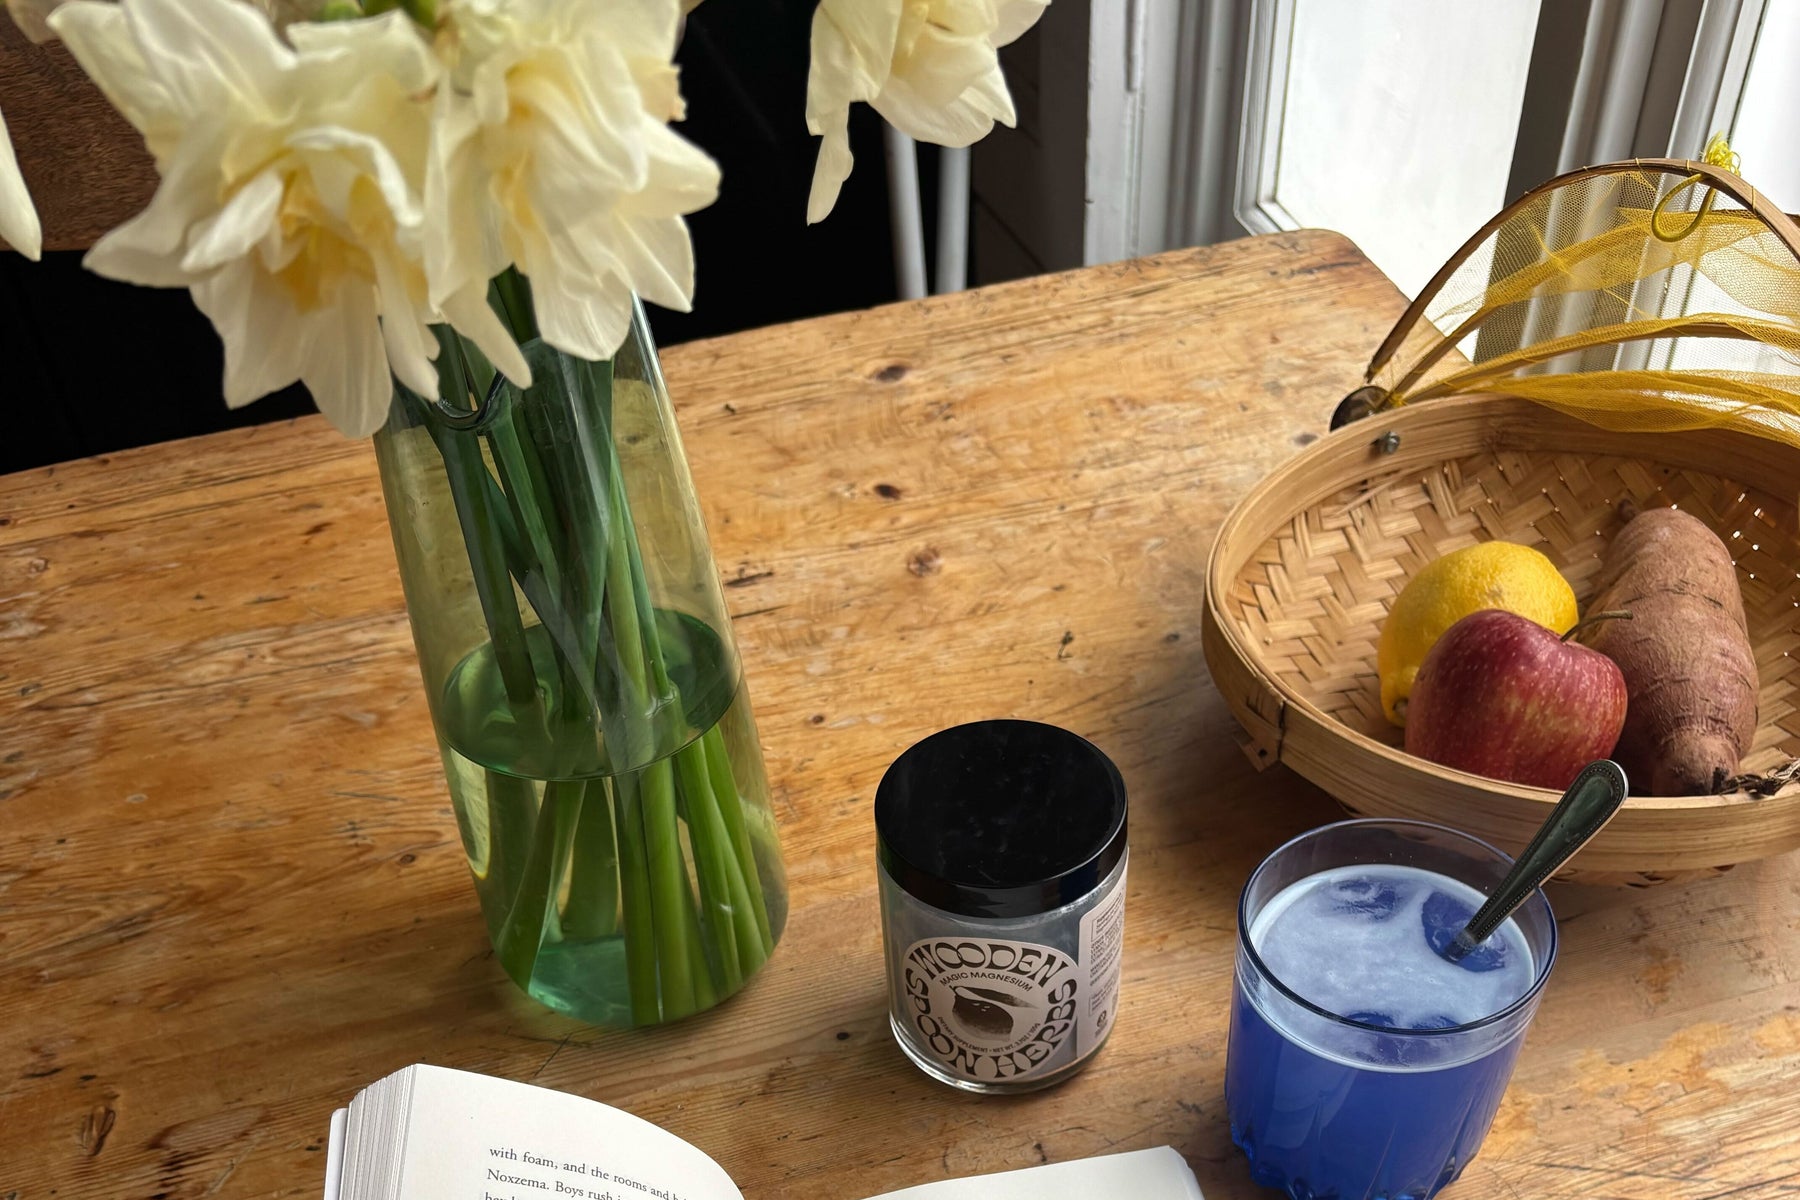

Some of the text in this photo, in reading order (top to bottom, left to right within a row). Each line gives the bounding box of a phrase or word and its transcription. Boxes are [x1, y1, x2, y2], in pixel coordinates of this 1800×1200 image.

[909, 942, 1069, 988] WOODEN
[940, 971, 1033, 992] MAGIC MAGNESIUM
[906, 968, 1078, 1078] SPOON HERBS
[486, 1168, 550, 1190] Noxzema.
[554, 1180, 584, 1199] Boys
